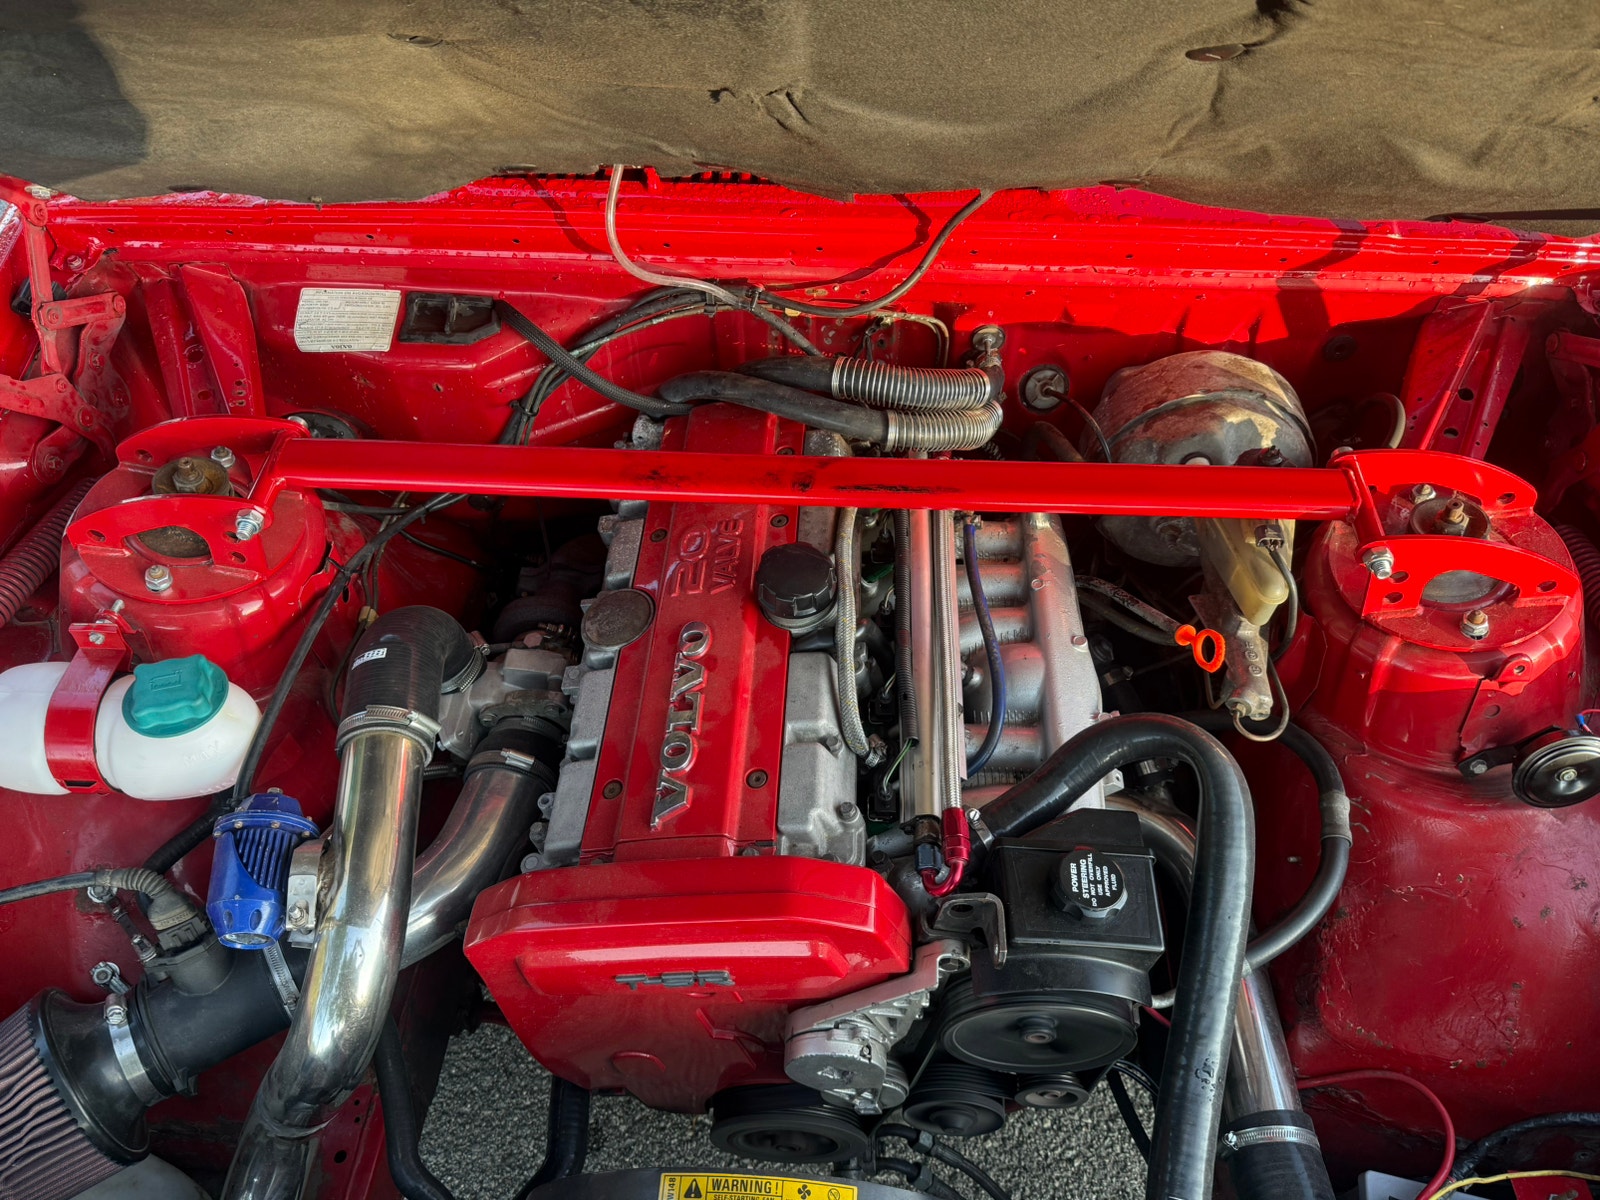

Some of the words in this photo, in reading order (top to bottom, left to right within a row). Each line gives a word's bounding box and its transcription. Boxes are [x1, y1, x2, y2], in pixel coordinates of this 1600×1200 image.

[671, 524, 711, 598] 20
[710, 517, 745, 596] VALVE
[651, 621, 712, 832] VOLVO
[1070, 862, 1079, 893] POWER
[1080, 859, 1090, 899] STEERING
[1087, 853, 1095, 881] OVERFILL
[1102, 865, 1111, 897] APPROVED
[1091, 897, 1097, 907] DO
